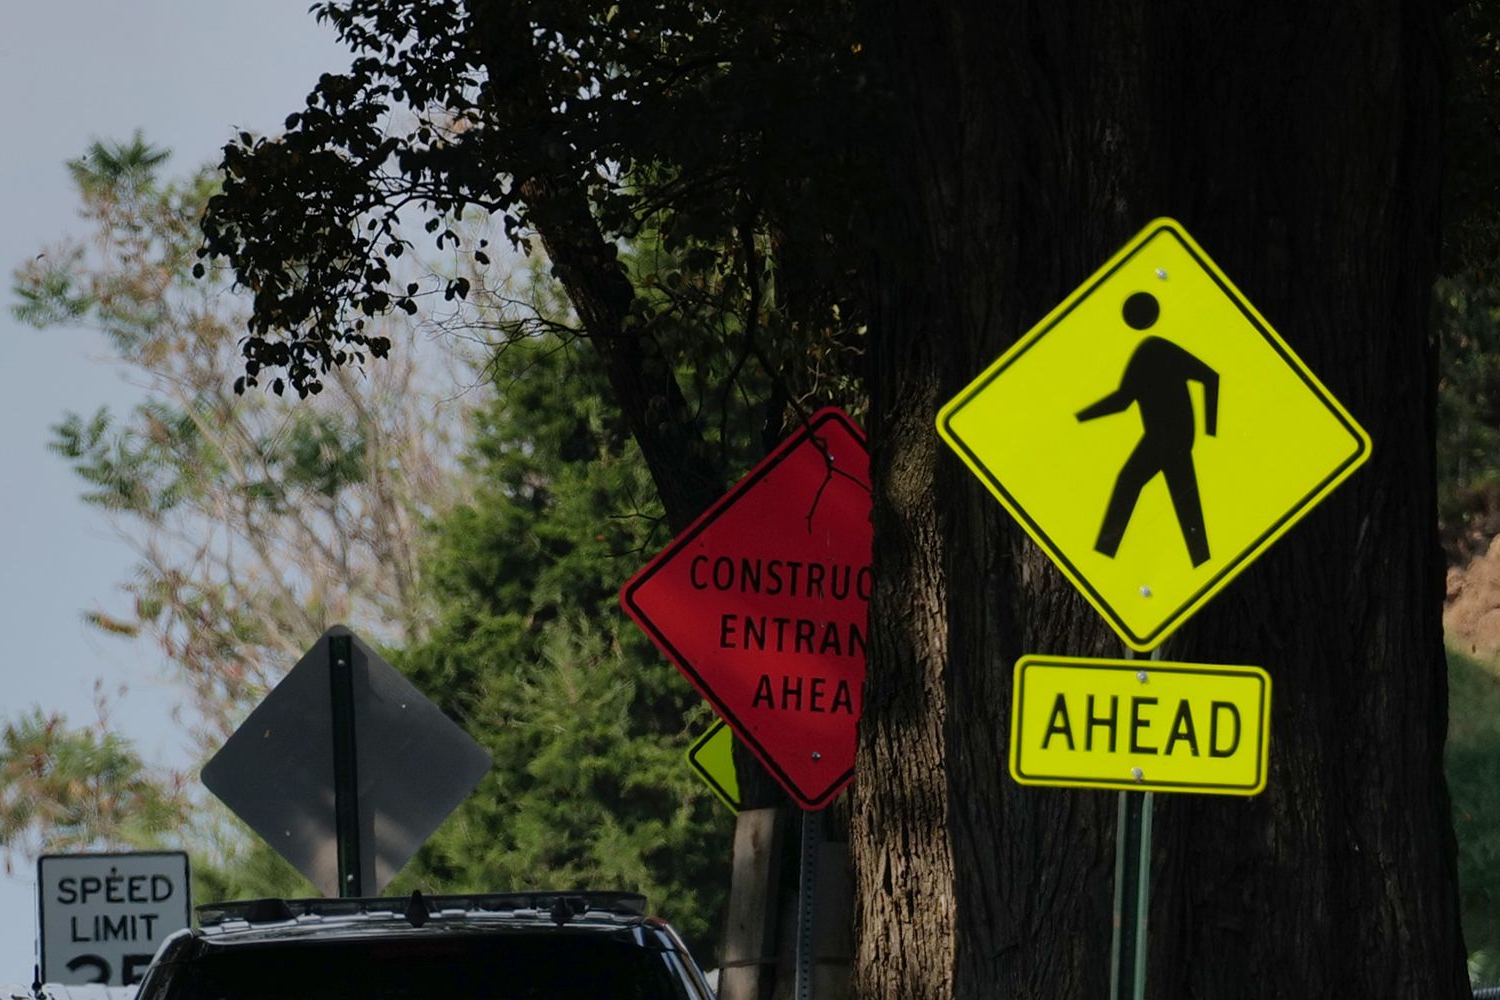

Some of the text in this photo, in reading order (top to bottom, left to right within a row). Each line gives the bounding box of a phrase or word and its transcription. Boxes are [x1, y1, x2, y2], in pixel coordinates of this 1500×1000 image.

[751, 673, 865, 715] AHEA
[1041, 692, 1242, 759] AHEAD
[56, 874, 174, 905] SPEED
[71, 913, 159, 943] LIMIT
